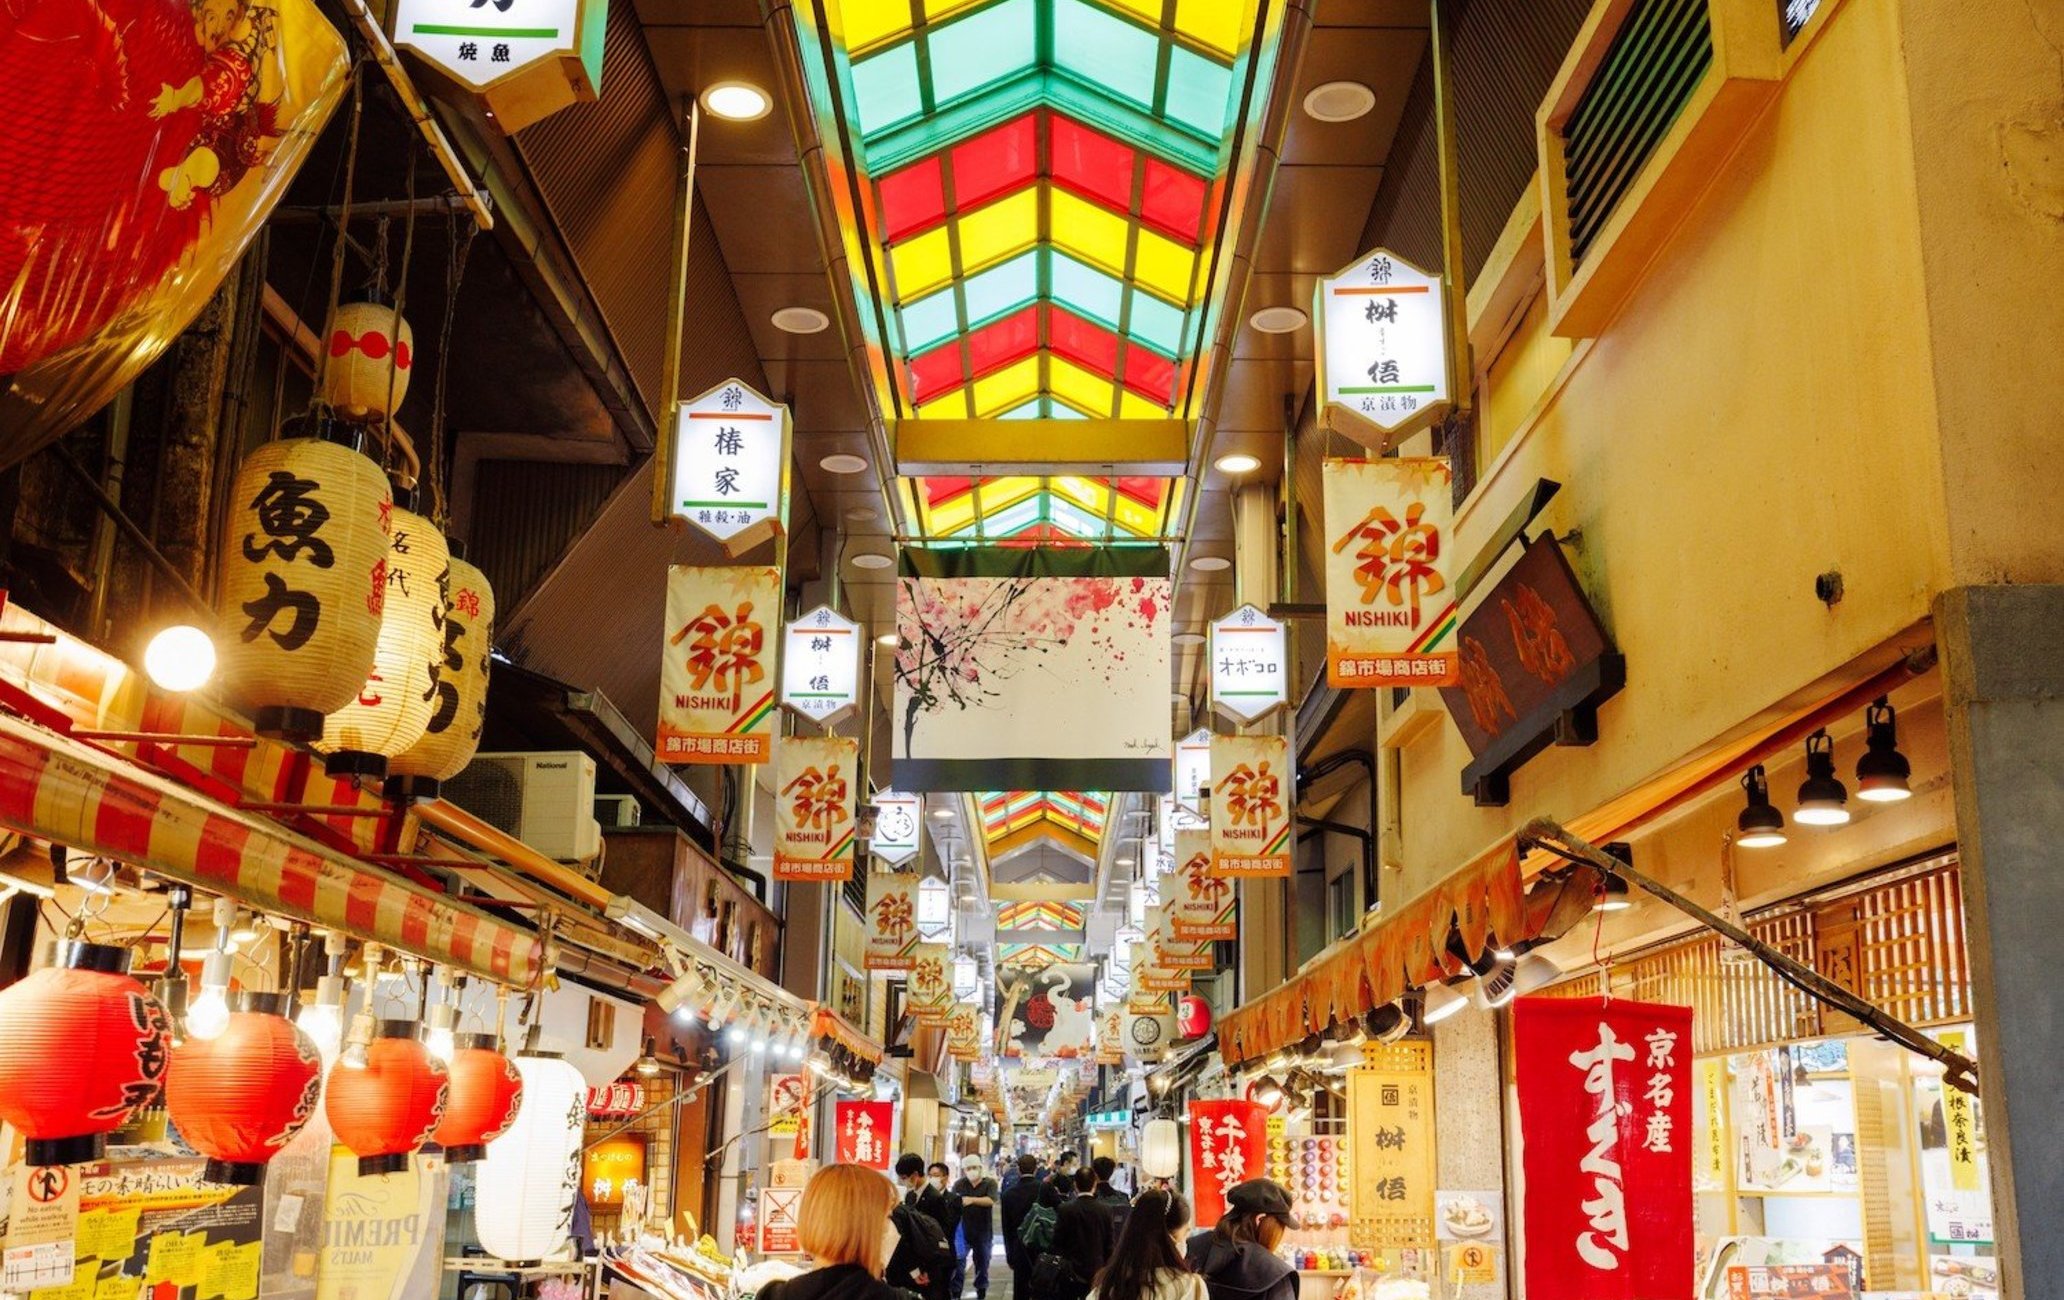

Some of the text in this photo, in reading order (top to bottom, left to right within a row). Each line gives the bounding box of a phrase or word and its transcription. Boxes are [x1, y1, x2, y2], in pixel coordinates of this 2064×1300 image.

[458, 42, 510, 62] 焼魚
[1361, 395, 1417, 411] 京漬物
[714, 426, 744, 496] 椿家
[241, 471, 335, 650] 魚力
[387, 530, 412, 597] 名代
[1333, 502, 1445, 632] 錦
[1344, 610, 1409, 628] NISHIKI
[671, 600, 766, 716] 錦
[1338, 658, 1447, 677] 錦市場商店街
[675, 694, 731, 710] NISHIKI
[802, 699, 836, 709] 京漬物
[665, 737, 760, 756] 錦市場商店街
[781, 764, 848, 846] 錦
[1214, 760, 1282, 842] 錦
[786, 832, 825, 842] NISHIKI
[1222, 829, 1261, 840] NISHIKI
[779, 861, 845, 874] 錦市場商店街
[1218, 858, 1283, 870] 錦市場商店街
[1642, 1028, 1678, 1152] 京名産
[1408, 1084, 1418, 1120] 京漬物
[1569, 1021, 1636, 1270] すぐき
